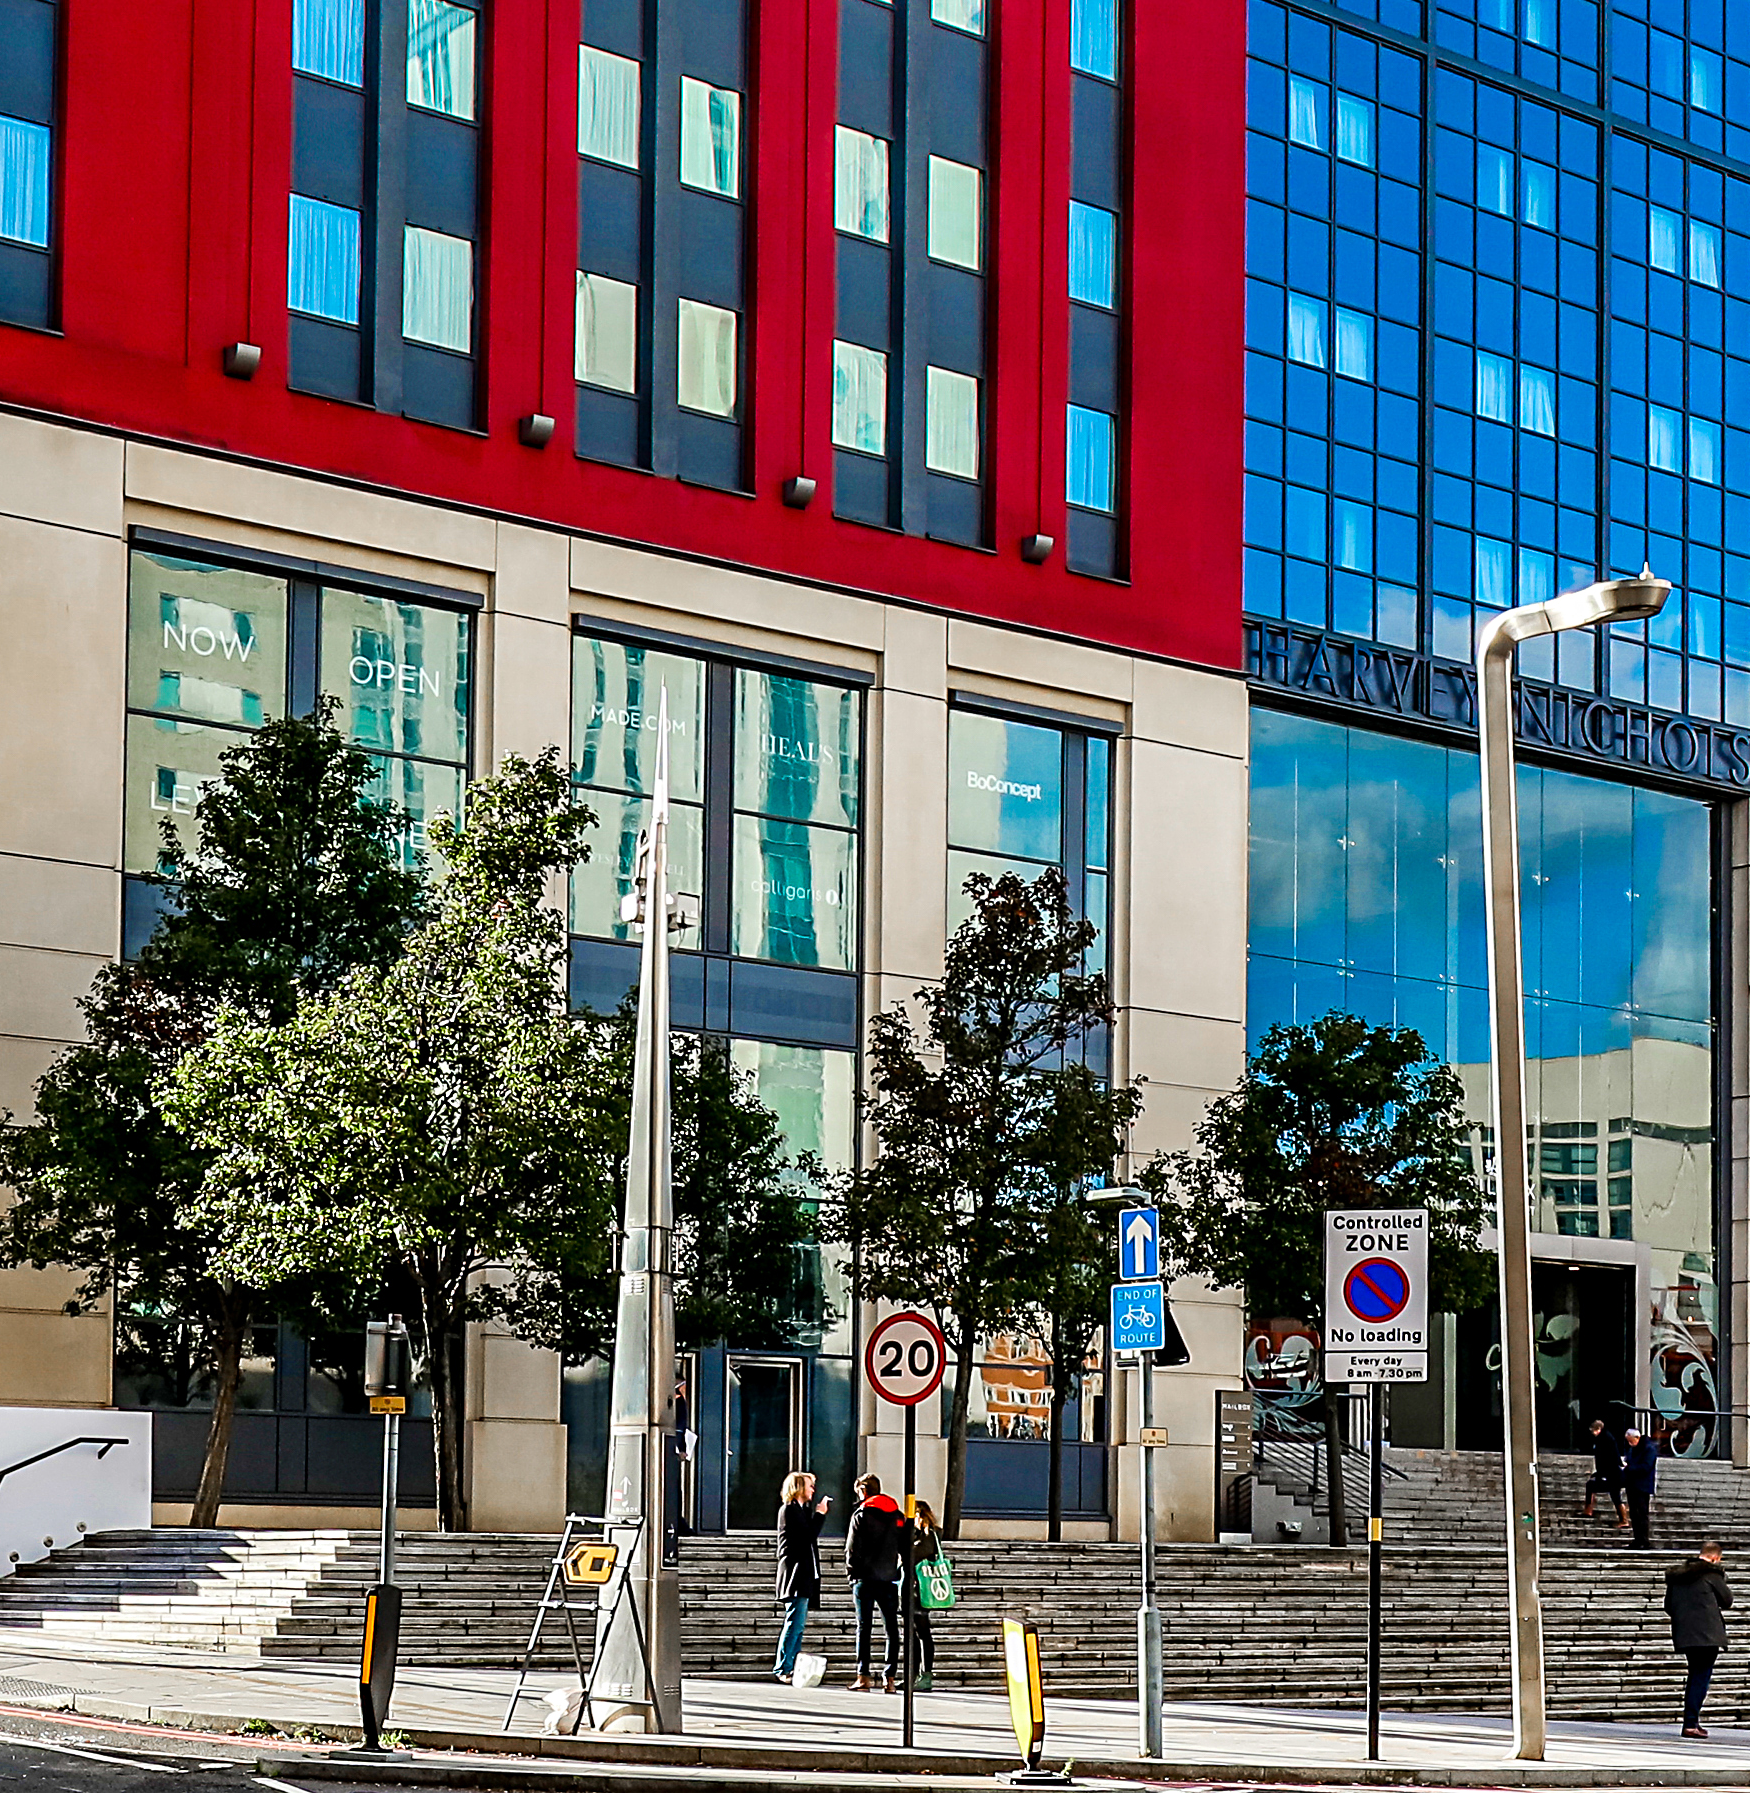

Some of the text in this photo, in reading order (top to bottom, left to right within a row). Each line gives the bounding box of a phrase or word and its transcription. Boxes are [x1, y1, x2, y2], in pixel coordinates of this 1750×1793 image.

[163, 621, 440, 697] NOW OPEN
[1258, 620, 1480, 728] HARVEY
[967, 770, 1041, 802] BoConcept
[1333, 1215, 1423, 1230] Controlled
[1345, 1234, 1409, 1252] ZONE
[1117, 1289, 1157, 1301] END OF
[1120, 1332, 1156, 1344] ROUTE
[1331, 1328, 1422, 1344] No loading
[879, 1339, 934, 1378] 20
[1350, 1356, 1402, 1367] Every day
[1347, 1369, 1354, 1378] 8
[1356, 1370, 1372, 1378] am
[1379, 1368, 1404, 1378] 7.30
[1406, 1370, 1422, 1380] pm
